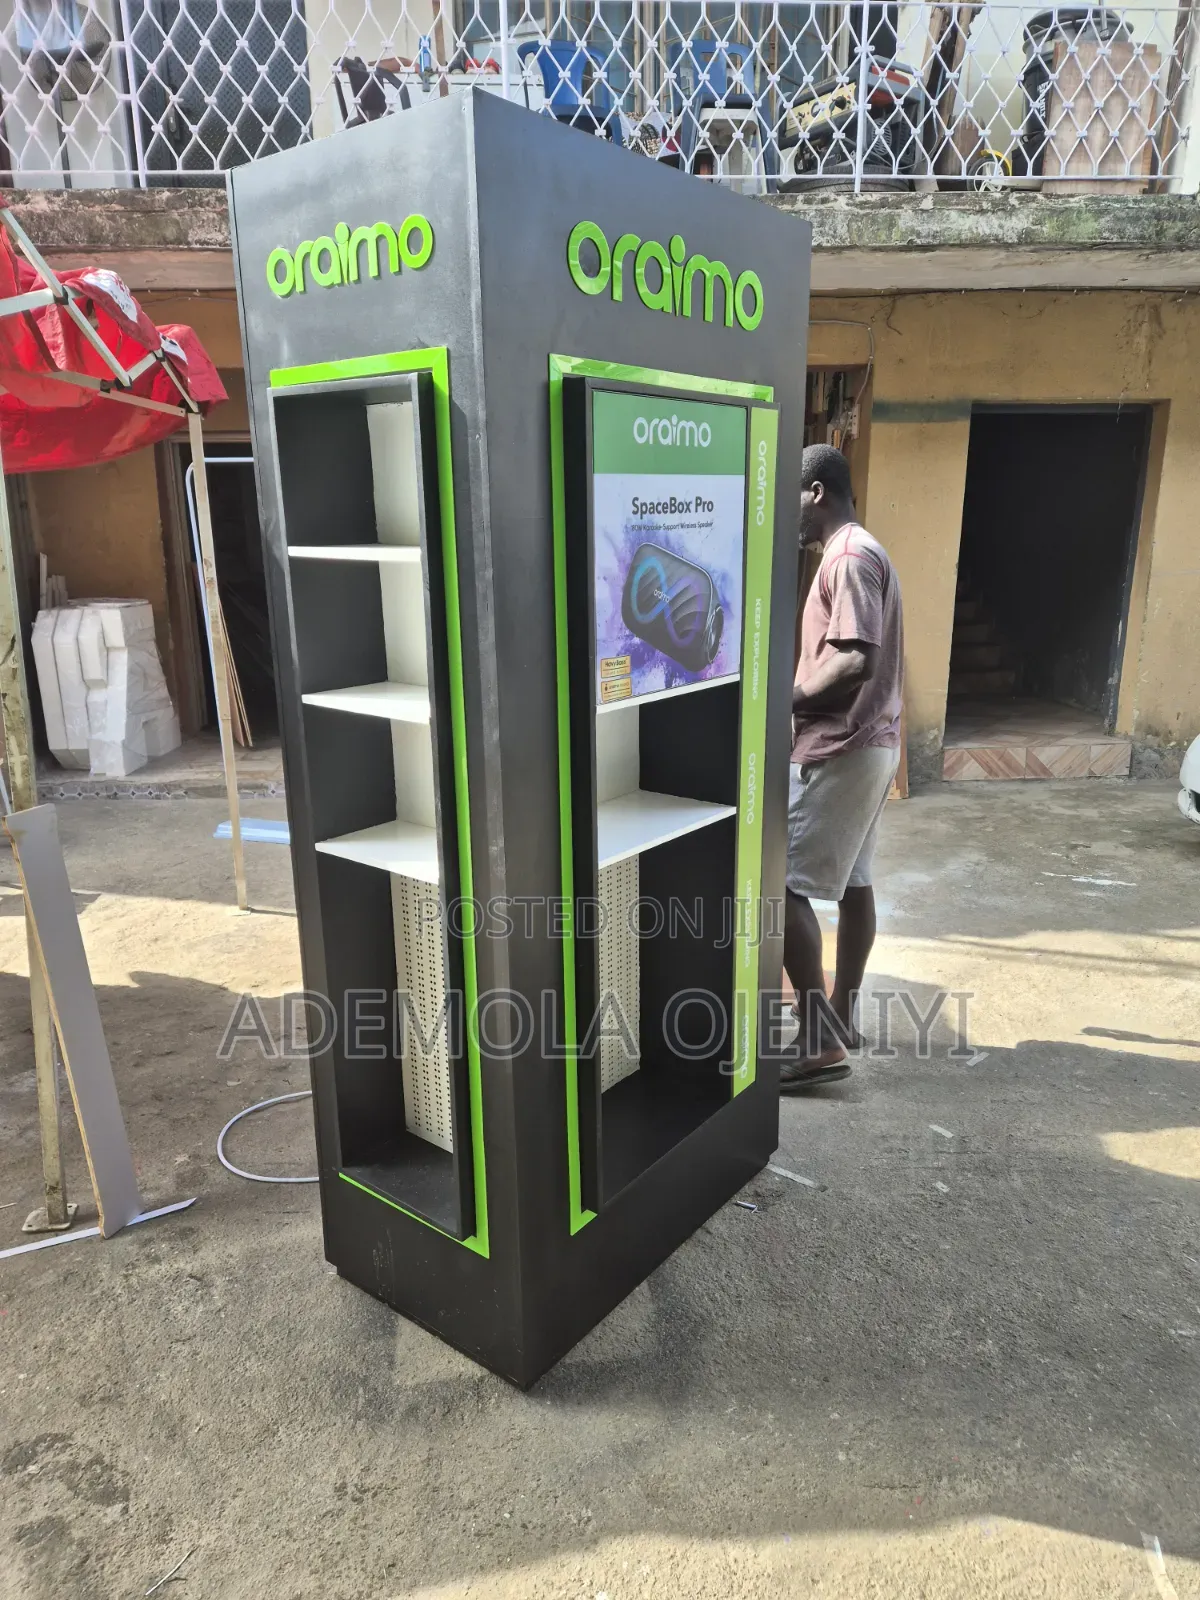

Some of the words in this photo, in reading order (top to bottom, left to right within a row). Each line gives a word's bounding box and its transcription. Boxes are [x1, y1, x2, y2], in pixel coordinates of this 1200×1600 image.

[266, 213, 434, 298] oraimo
[567, 220, 764, 331] oraimo
[633, 414, 711, 448] oraimo
[631, 496, 692, 520] SpaceBox
[694, 495, 714, 513] Pro
[757, 440, 767, 526] oraimo
[747, 752, 756, 824] oraimo
